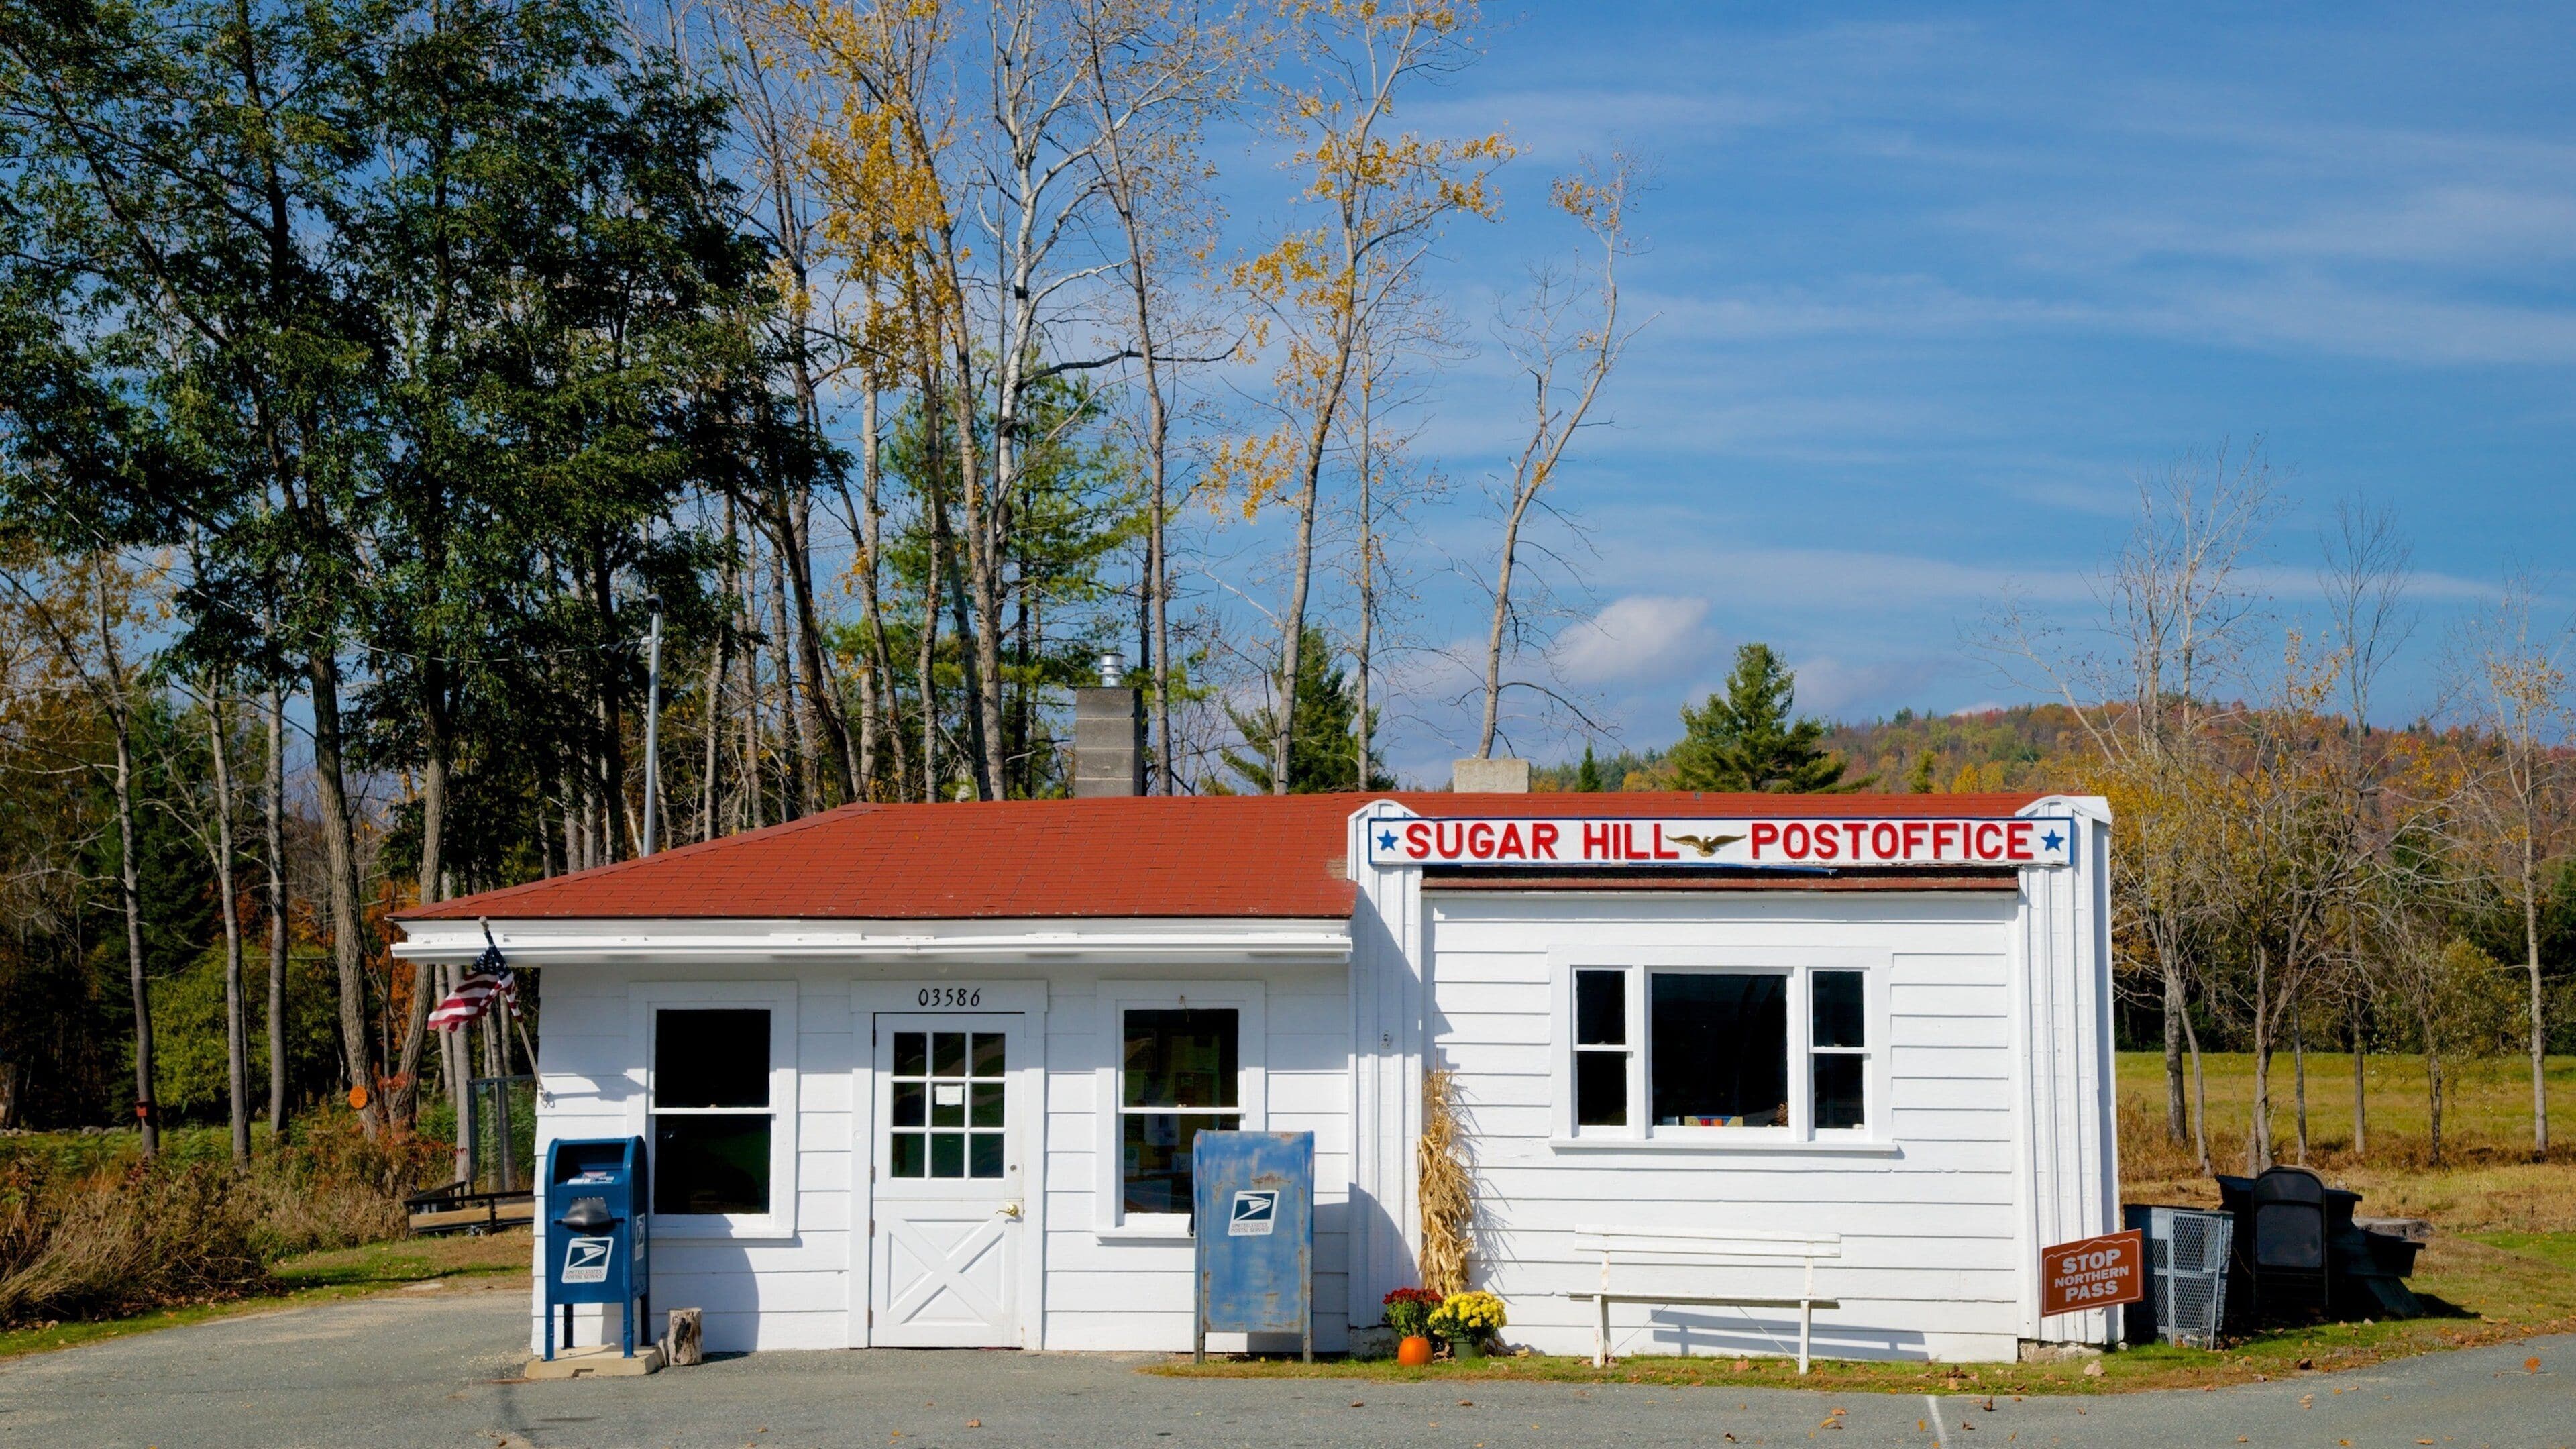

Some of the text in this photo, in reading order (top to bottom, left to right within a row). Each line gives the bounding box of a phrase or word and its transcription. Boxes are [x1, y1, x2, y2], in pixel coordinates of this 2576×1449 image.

[1405, 822, 1558, 860] SUGAR
[1583, 822, 1680, 860] HILL
[918, 987, 981, 1007] 03586
[2061, 1248, 2121, 1274] STOP
[2054, 1265, 2129, 1288] NORTHERN
[2065, 1280, 2118, 1302] PASS
